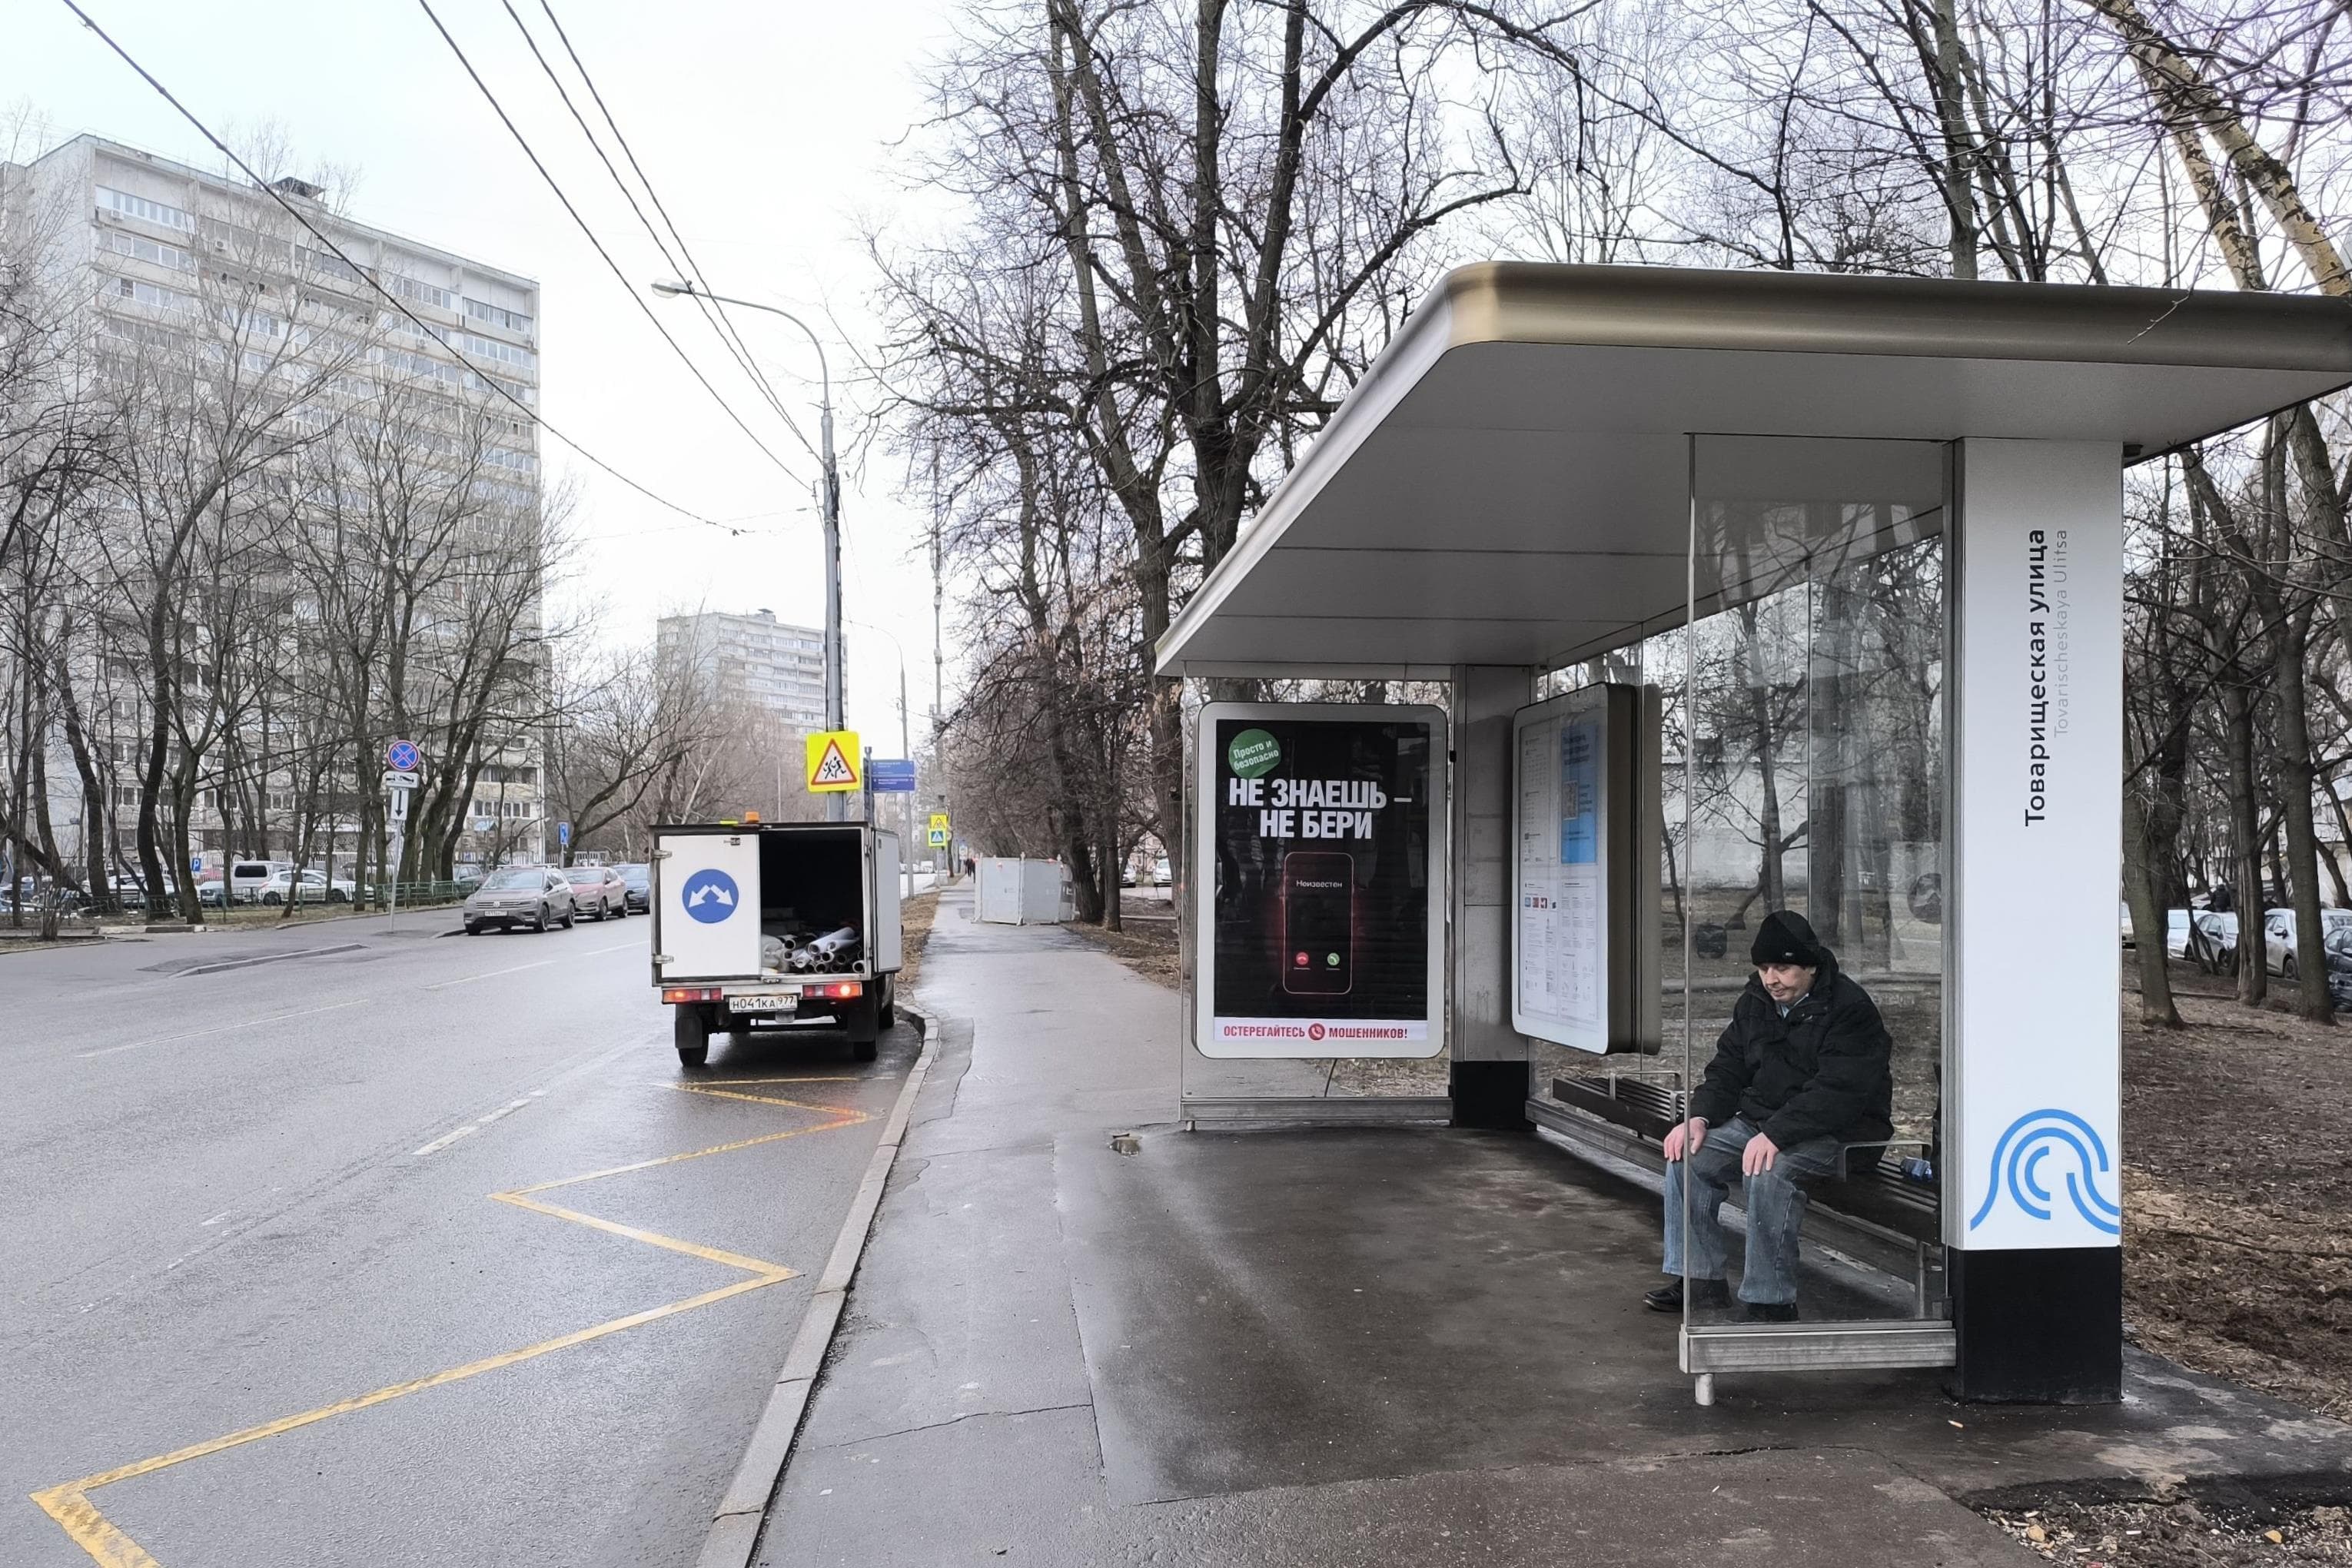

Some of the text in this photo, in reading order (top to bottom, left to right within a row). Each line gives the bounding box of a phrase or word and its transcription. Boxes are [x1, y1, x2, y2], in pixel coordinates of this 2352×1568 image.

[2054, 530, 2071, 738] Tovarischeskaya Ulitsa
[2025, 529, 2050, 827] Товарищеская улица
[1233, 742, 1264, 759] Просто
[1234, 749, 1279, 770] безопасно
[1229, 778, 1264, 806] НЕ
[1271, 779, 1387, 809] ЗНАЕШЬ
[1260, 809, 1373, 839] НЕ БЕРИ
[1224, 1025, 1407, 1038] ОСТЕРЕГАЙТЕСЬ МОШЕННИКОВ!
